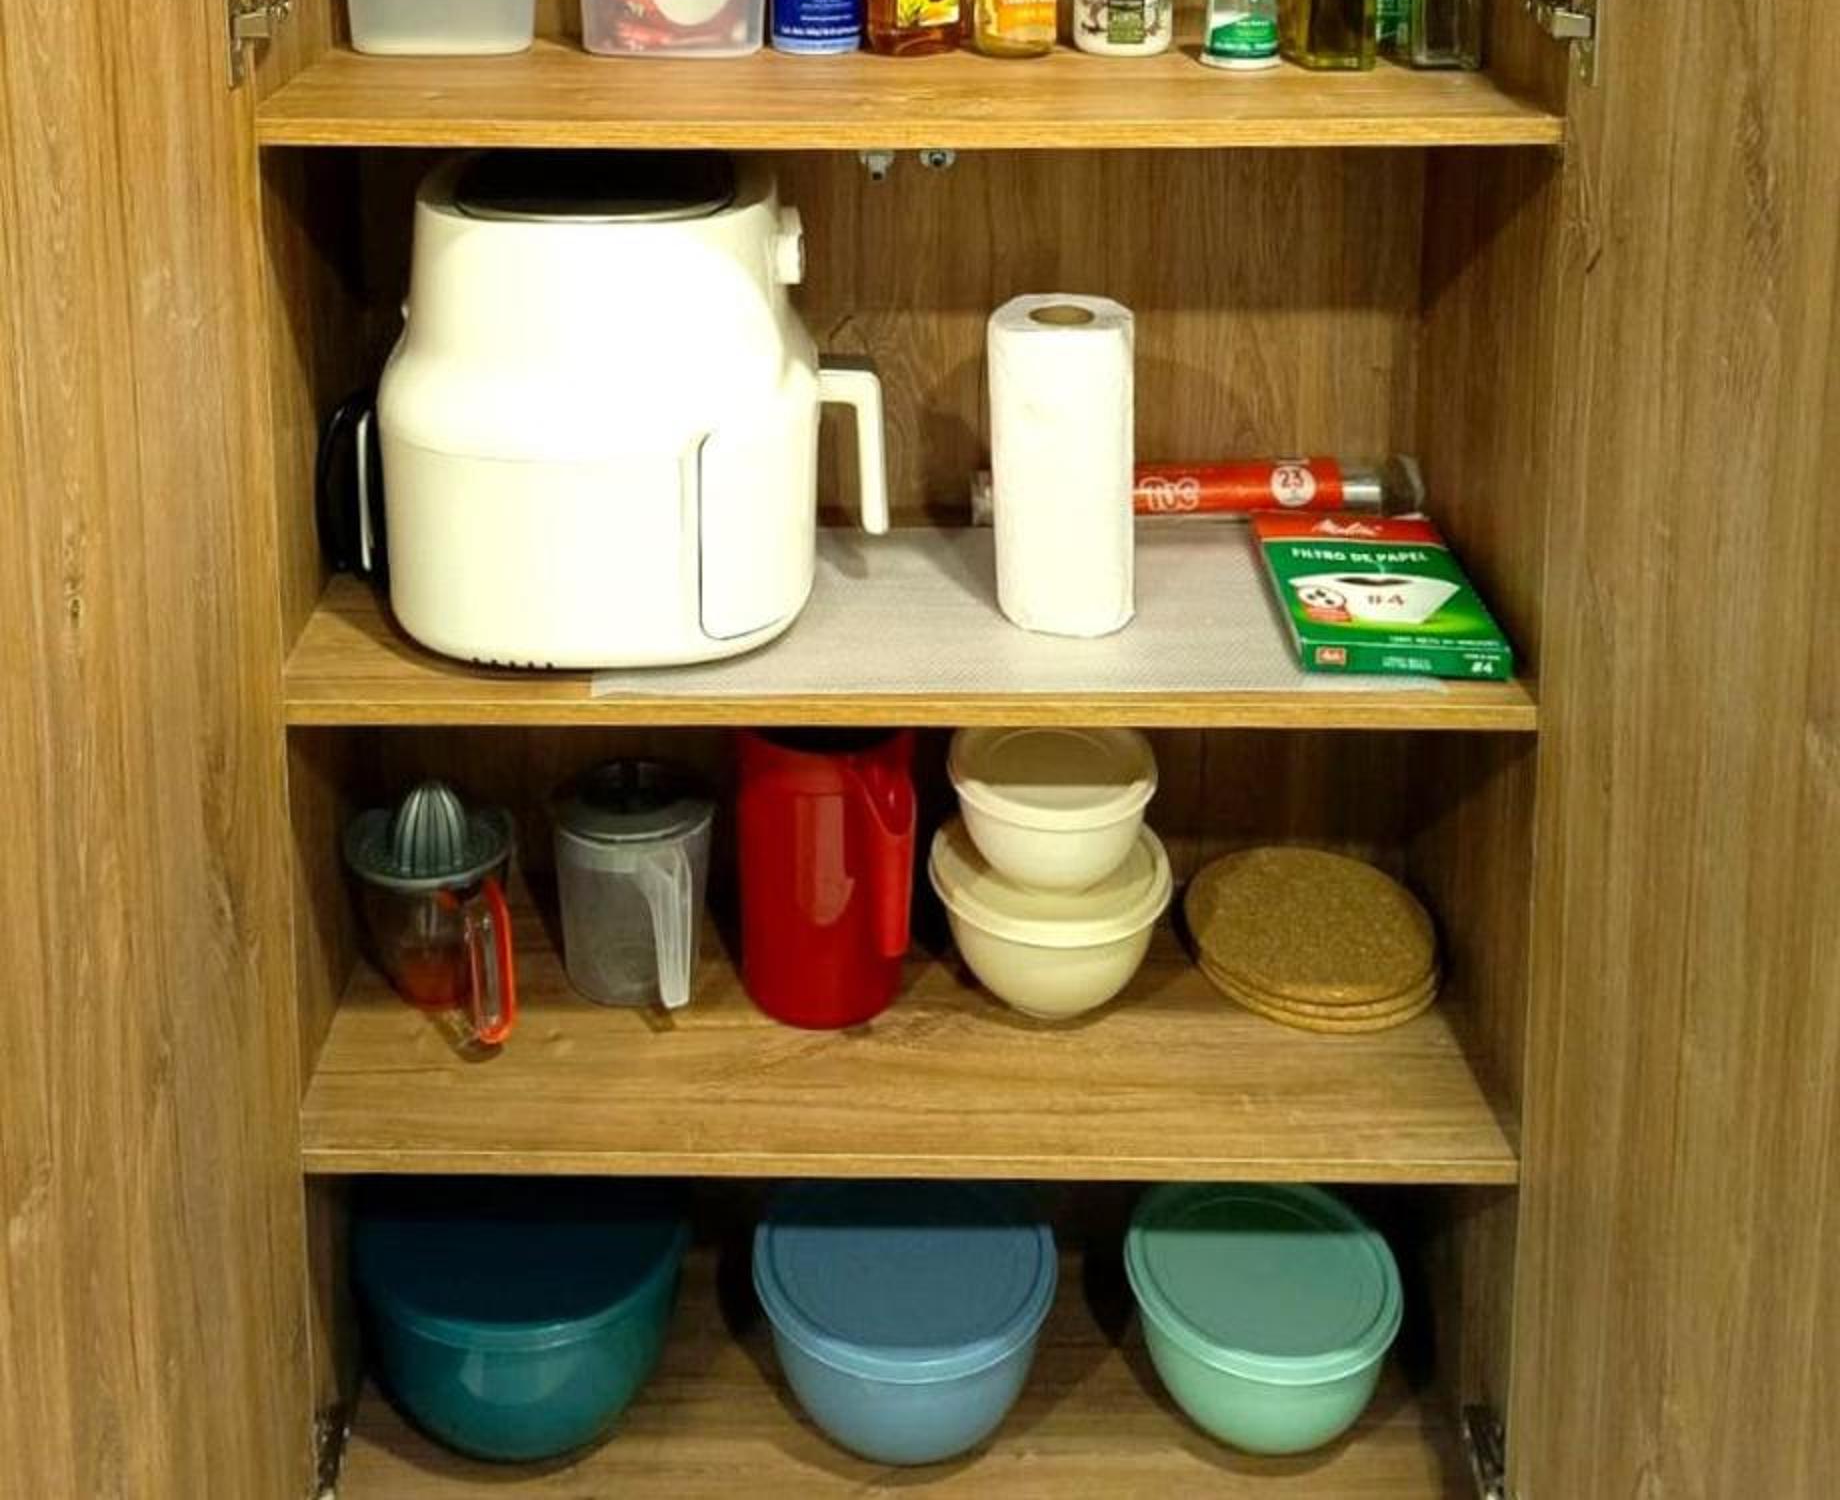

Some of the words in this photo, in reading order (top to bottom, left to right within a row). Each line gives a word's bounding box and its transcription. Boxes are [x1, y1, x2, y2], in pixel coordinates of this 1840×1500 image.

[1278, 468, 1305, 488] 23
[1291, 547, 1346, 562] FILTRO
[1350, 552, 1374, 563] DE
[1375, 550, 1429, 563] PAPEL
